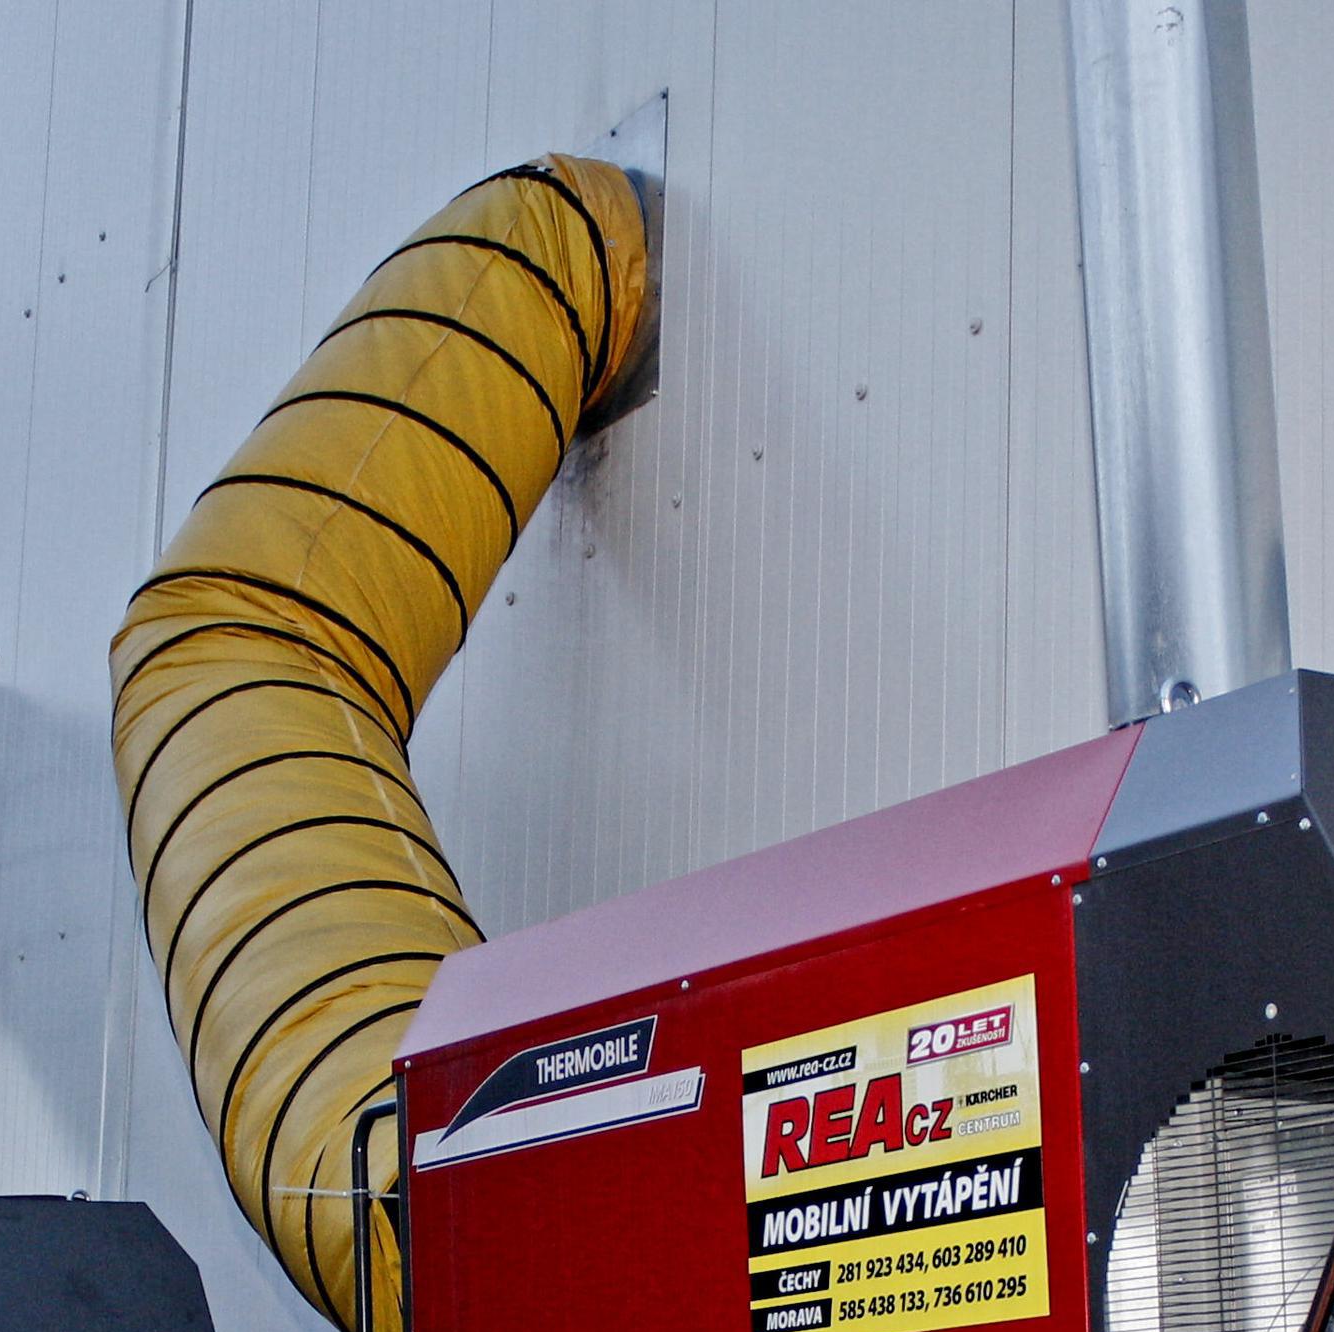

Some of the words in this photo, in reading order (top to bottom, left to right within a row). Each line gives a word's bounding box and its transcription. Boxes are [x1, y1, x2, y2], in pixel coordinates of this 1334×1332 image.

[535, 1032, 638, 1085] THERMOBILE
[909, 1023, 956, 1061] 20
[957, 1013, 1007, 1037] LET
[766, 1050, 853, 1087] www.rea-cz.cz
[958, 1110, 1021, 1137] CENTRUM
[762, 1186, 874, 1248] MOBILNÍ
[882, 1157, 1023, 1226] VYTÁPĚNÍ
[778, 1269, 822, 1293] ČECHY
[837, 1261, 862, 1284] 281
[867, 1256, 892, 1280] 923
[896, 1250, 930, 1274] 434,
[932, 1245, 961, 1269] 603
[964, 1239, 995, 1265] 289
[997, 1234, 1027, 1260] 410
[767, 1305, 823, 1331] MORAVA
[838, 1299, 866, 1322] 585
[868, 1294, 896, 1317] 438
[900, 1290, 930, 1313] 133,
[933, 1284, 962, 1308] 736
[965, 1280, 994, 1304] 610
[996, 1275, 1027, 1300] 295
